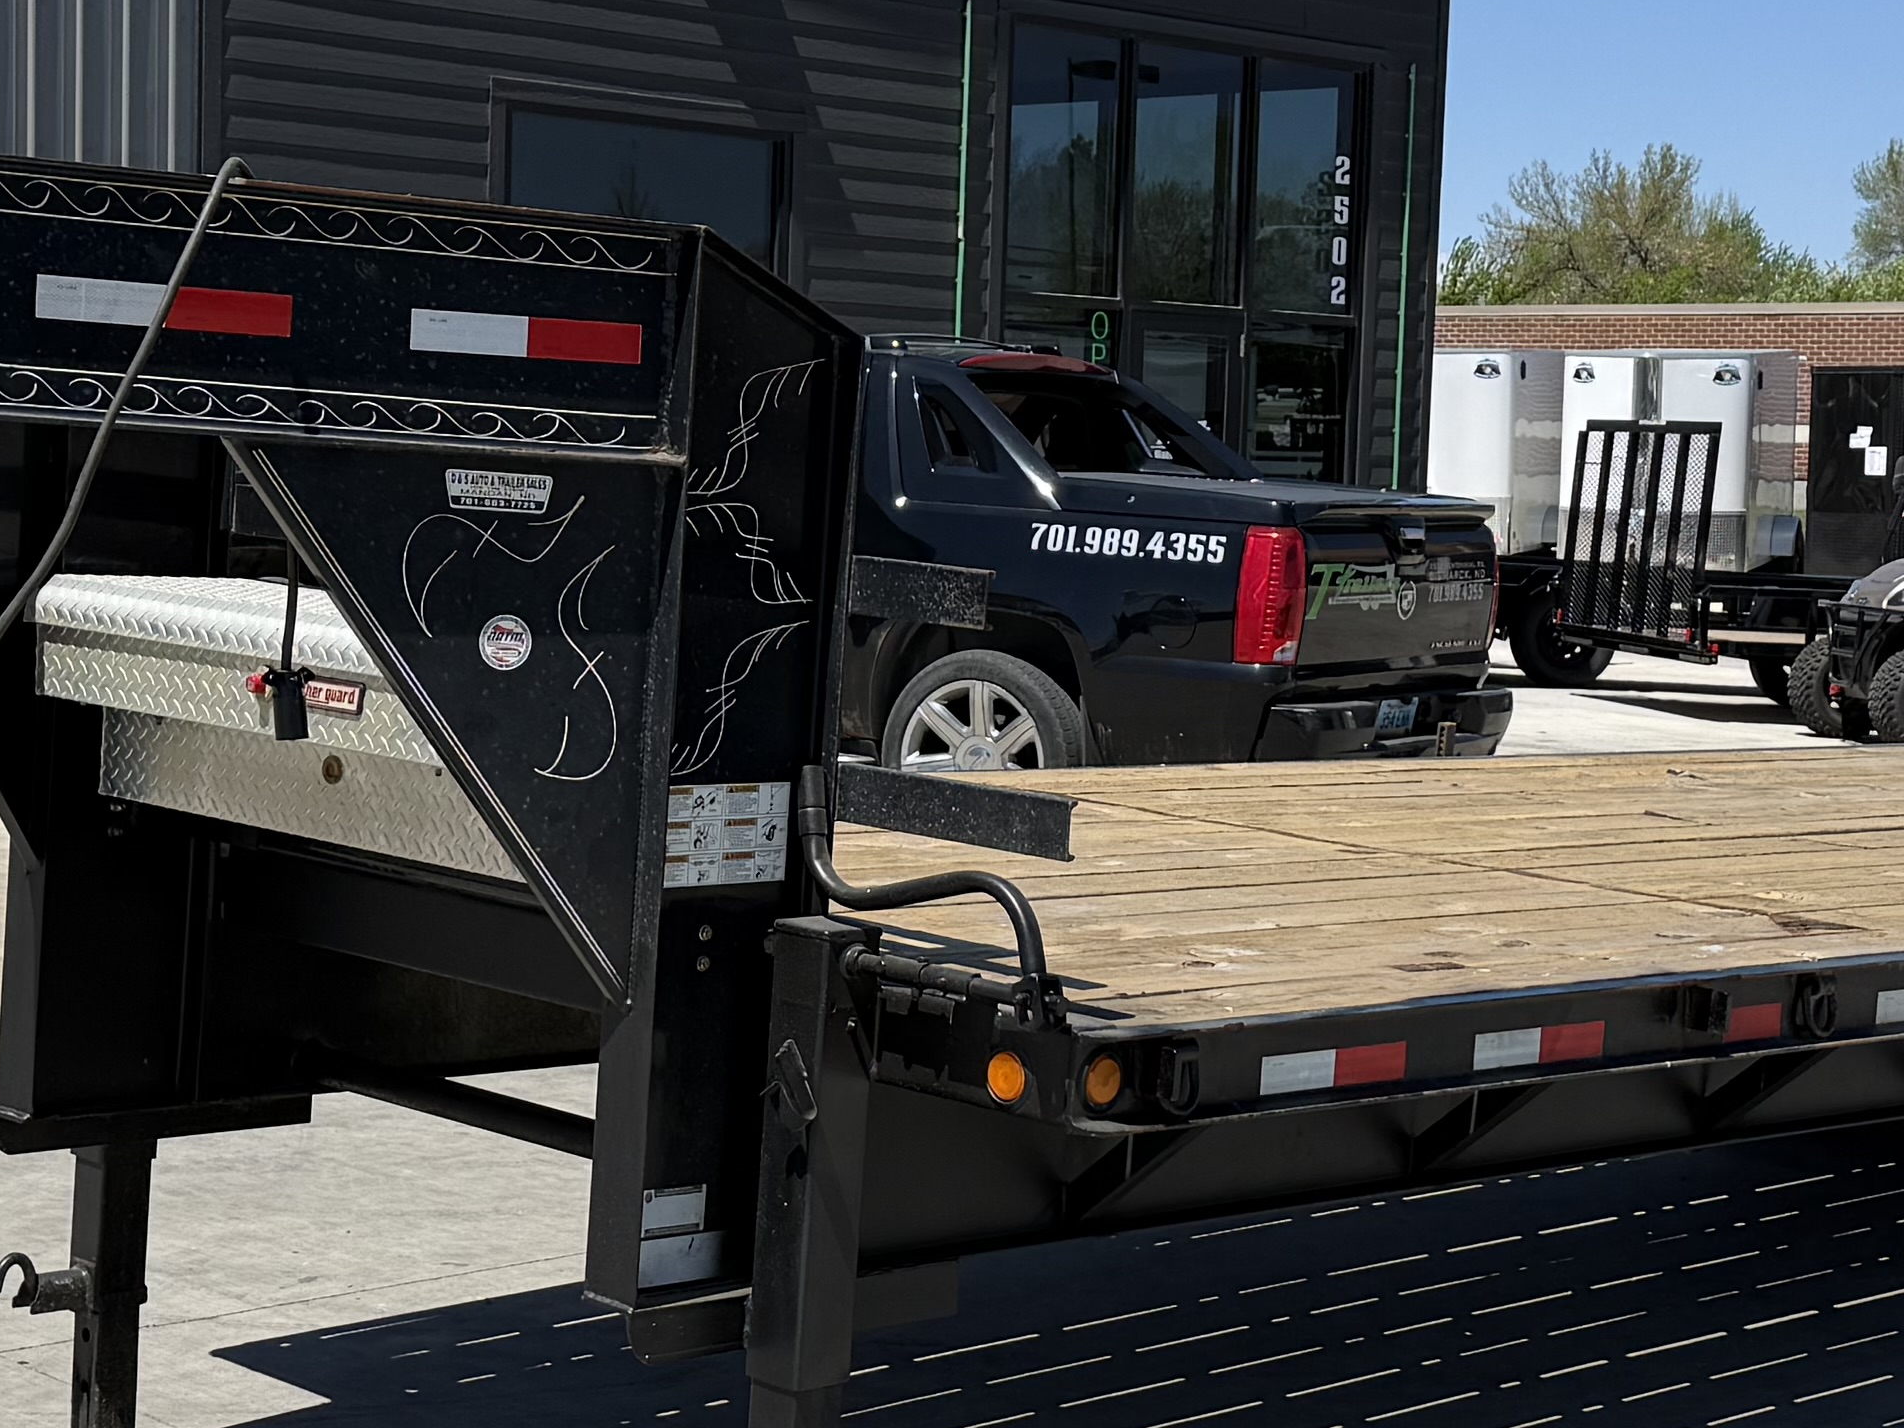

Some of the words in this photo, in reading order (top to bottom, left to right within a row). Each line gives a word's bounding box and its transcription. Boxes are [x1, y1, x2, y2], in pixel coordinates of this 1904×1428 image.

[1330, 155, 1351, 305] 2502
[1091, 311, 1108, 364] OP
[470, 474, 489, 486] AUTO
[1030, 522, 1227, 564] 701.989.4355
[324, 688, 356, 704] guard
